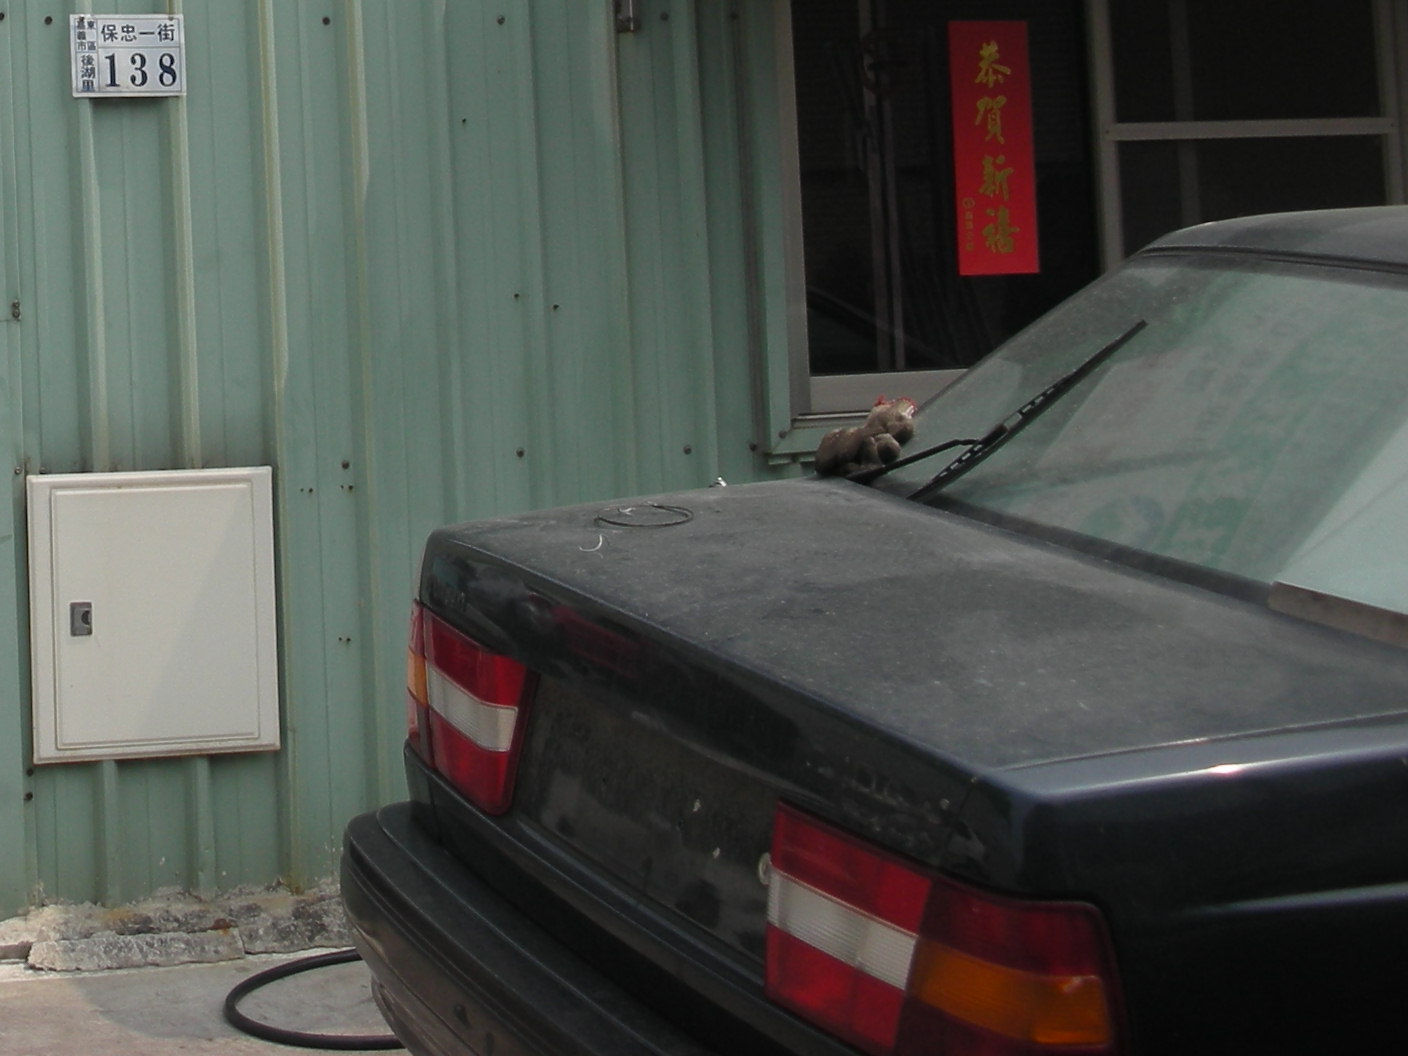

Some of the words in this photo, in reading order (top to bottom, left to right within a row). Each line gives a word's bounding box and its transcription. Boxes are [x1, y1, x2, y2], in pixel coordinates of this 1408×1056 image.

[100, 23, 175, 42] 保忠一街
[104, 52, 177, 88] 138
[974, 40, 1020, 254] 恭賀新禧
